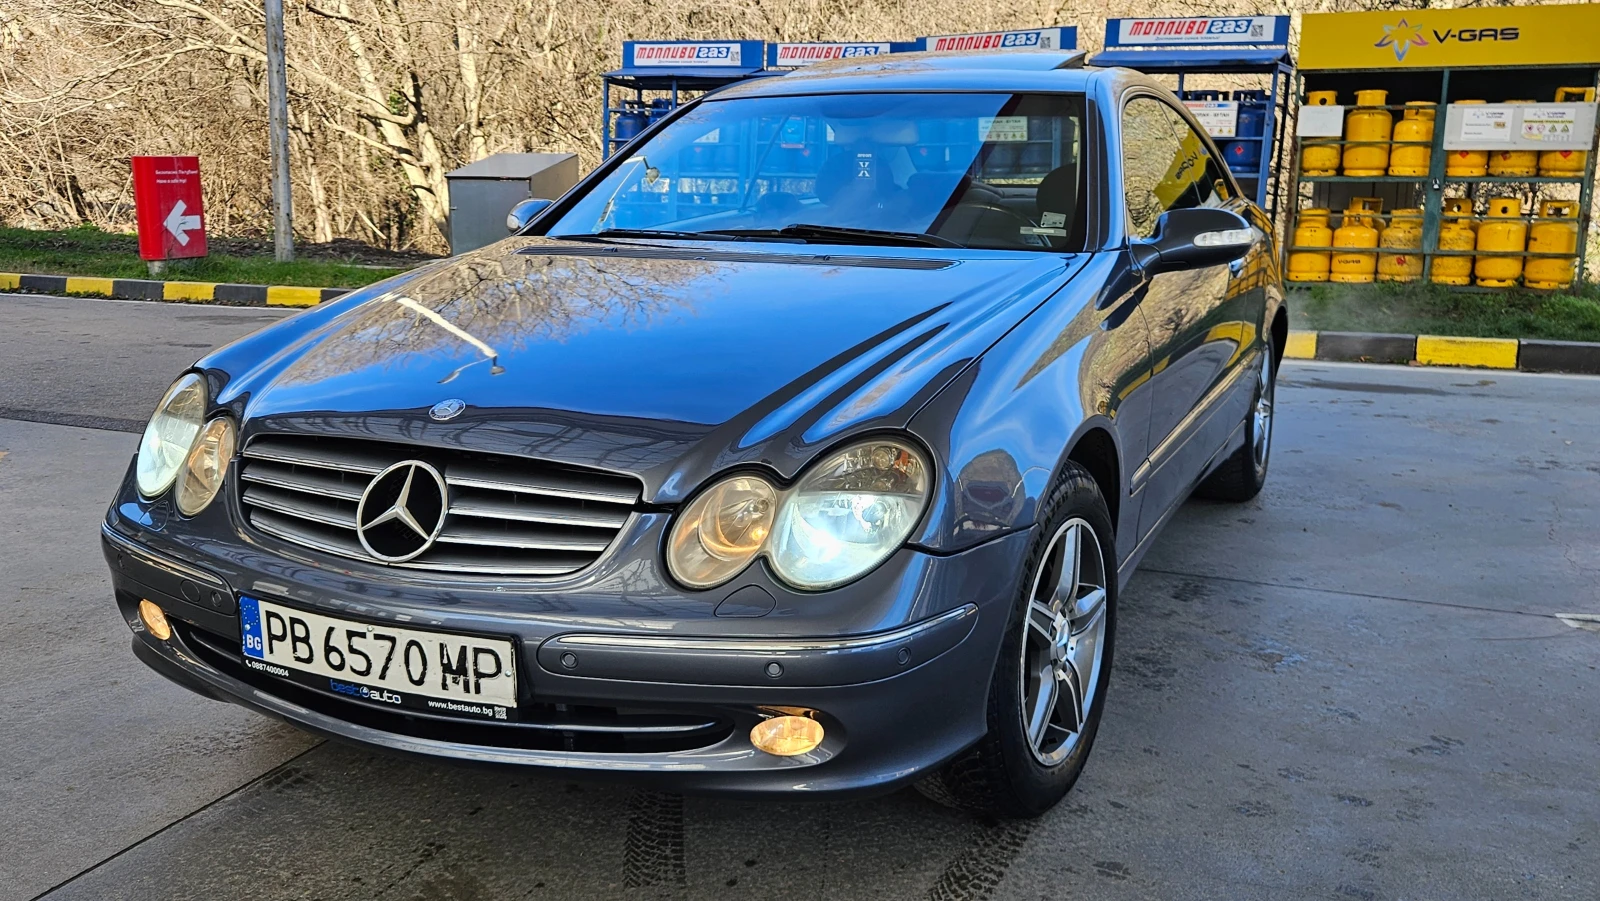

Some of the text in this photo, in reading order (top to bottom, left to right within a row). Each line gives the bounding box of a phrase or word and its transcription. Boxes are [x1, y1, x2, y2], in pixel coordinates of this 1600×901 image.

[1432, 27, 1520, 44] V-GAS
[246, 634, 261, 650] BG
[265, 609, 503, 694] PB 6570 MP
[428, 700, 493, 716] www.bestauto.bg
